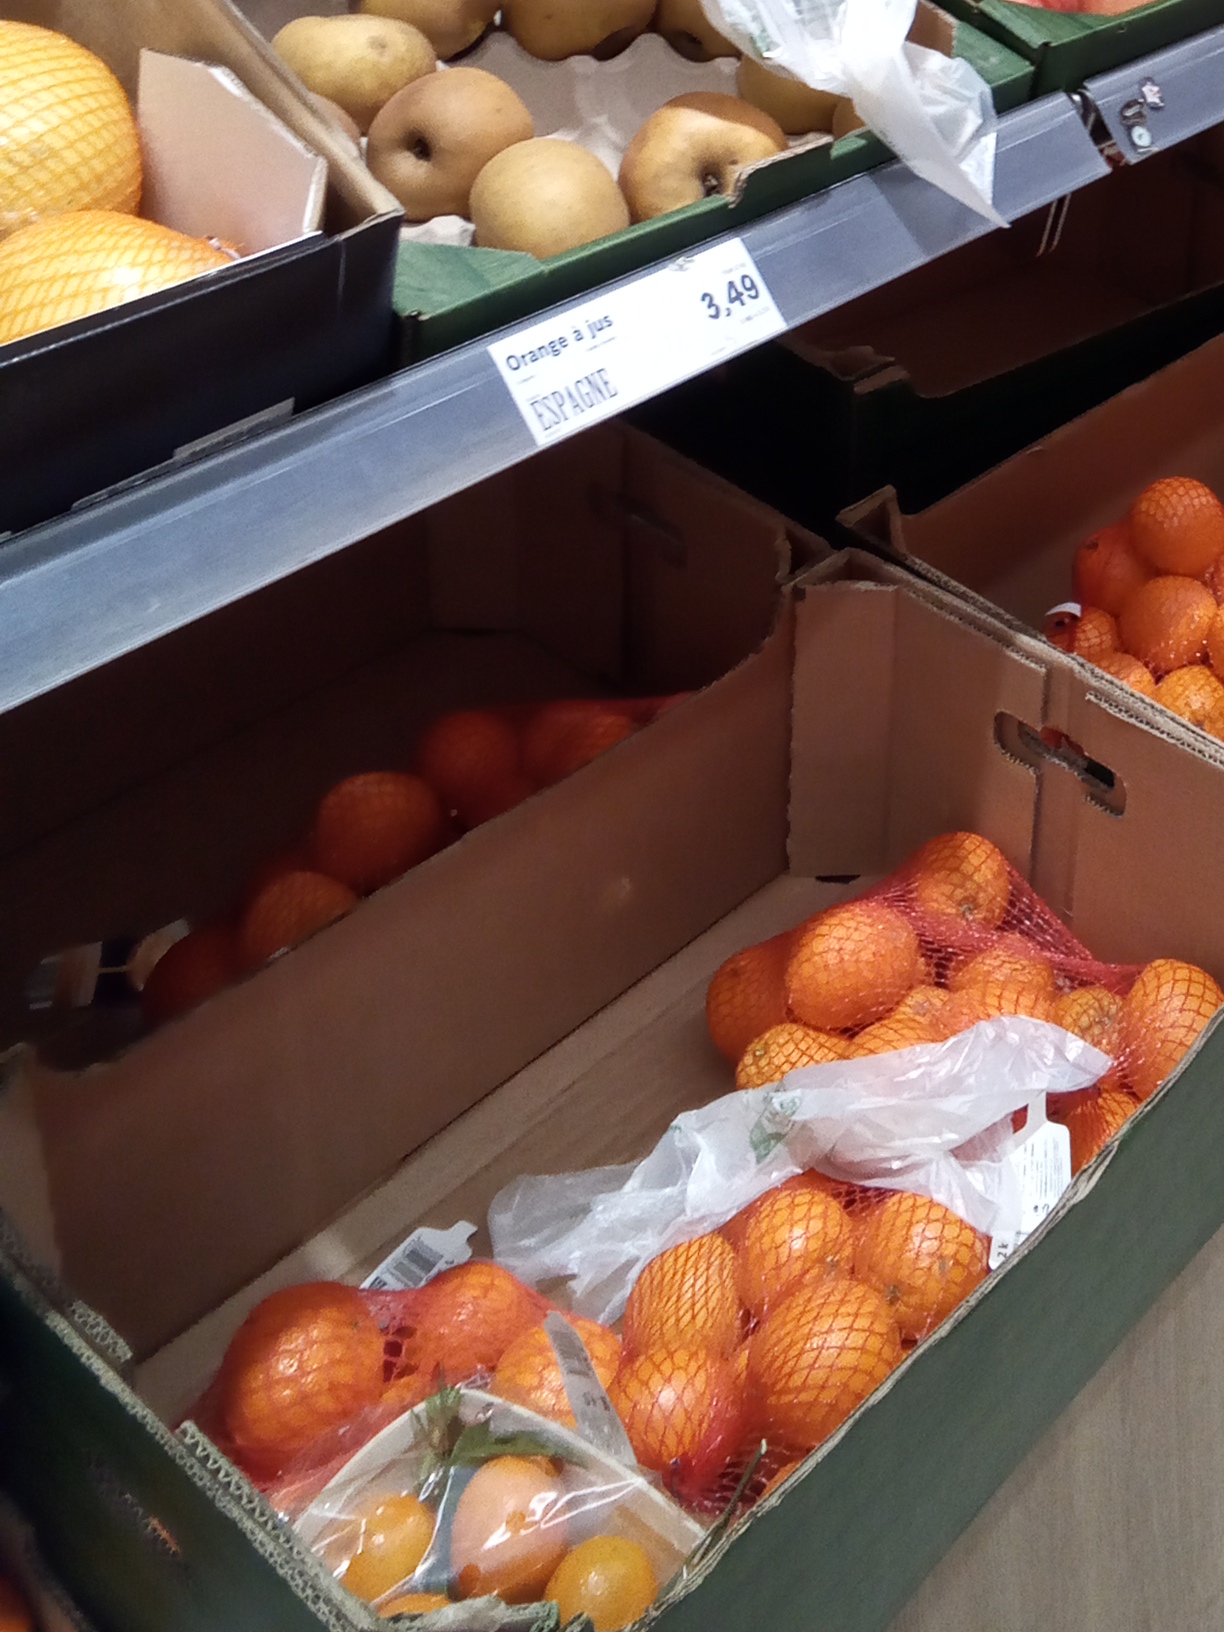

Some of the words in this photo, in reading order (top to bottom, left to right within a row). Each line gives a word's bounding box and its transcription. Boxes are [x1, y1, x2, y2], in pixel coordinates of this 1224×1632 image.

[700, 273, 760, 320] 3,49
[506, 336, 569, 371] Orange
[570, 325, 585, 342] à
[584, 314, 614, 340] jus
[529, 367, 619, 431] ESPAGNE
